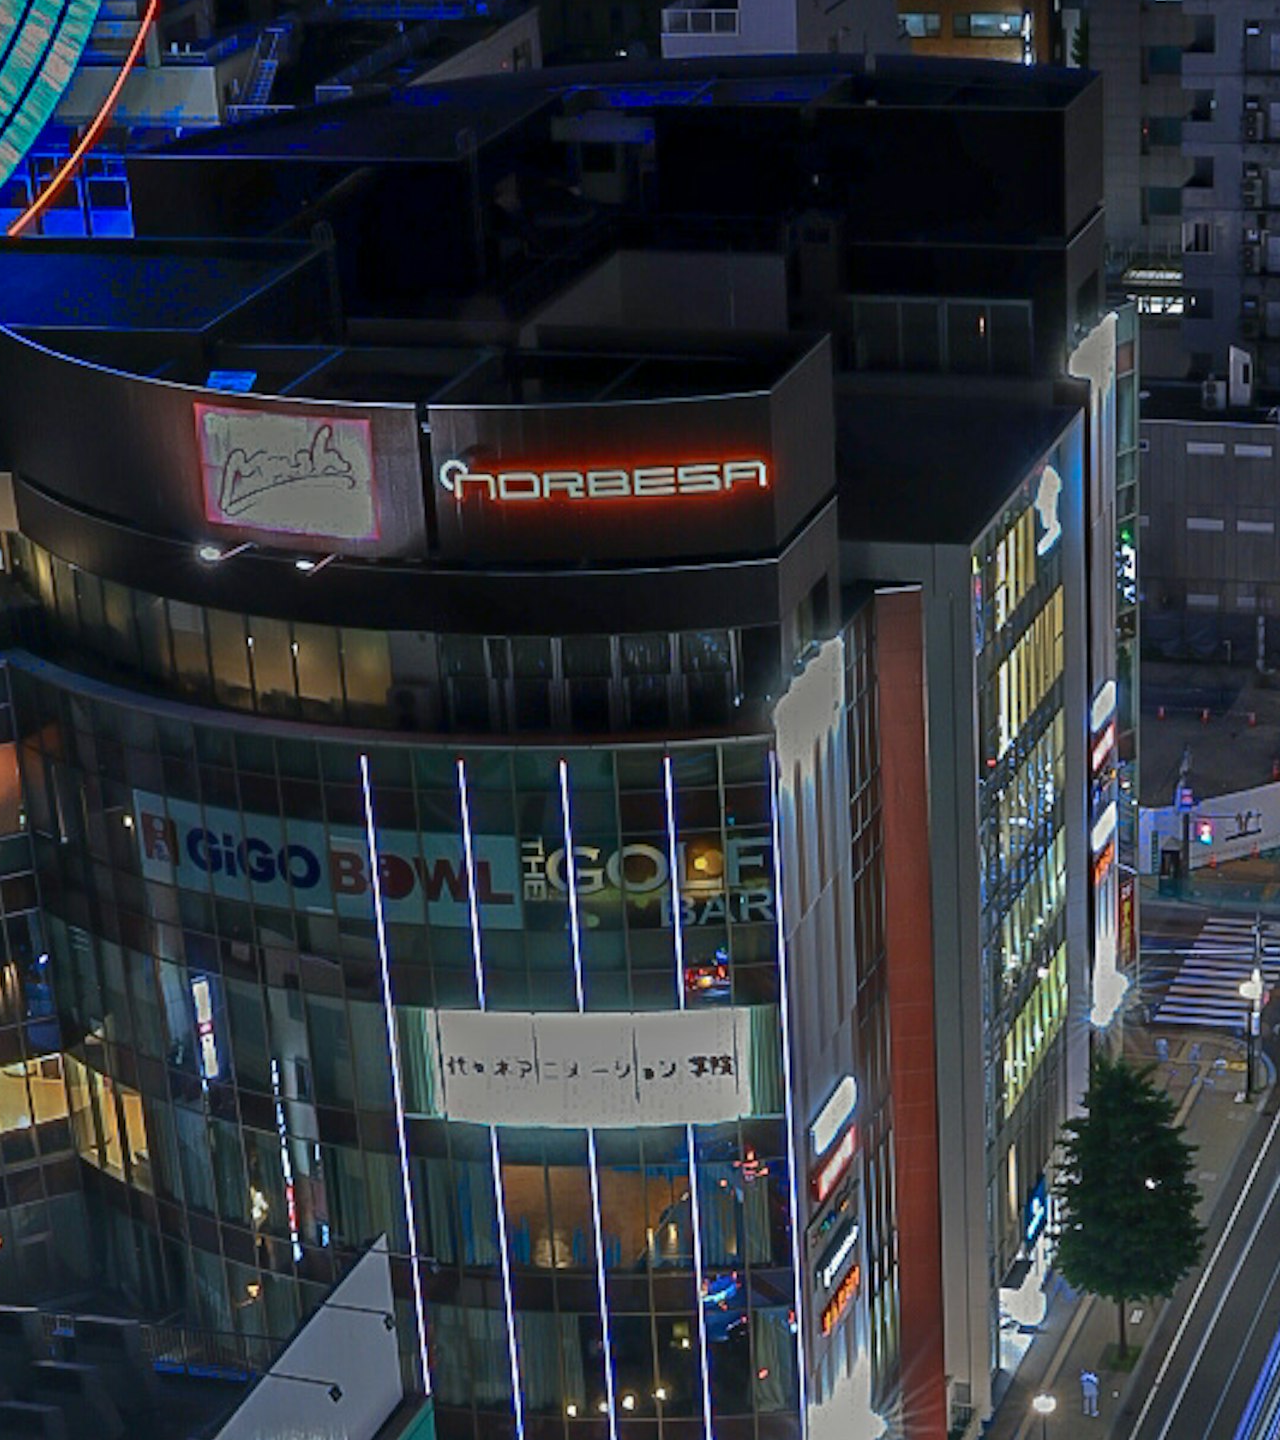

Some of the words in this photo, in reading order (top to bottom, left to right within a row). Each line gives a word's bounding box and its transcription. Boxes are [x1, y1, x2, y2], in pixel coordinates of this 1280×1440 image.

[186, 826, 321, 889] GiGO
[330, 848, 514, 906] BOWL
[521, 836, 548, 901] THE
[545, 836, 773, 894] GOLF
[659, 886, 776, 928] BAR
